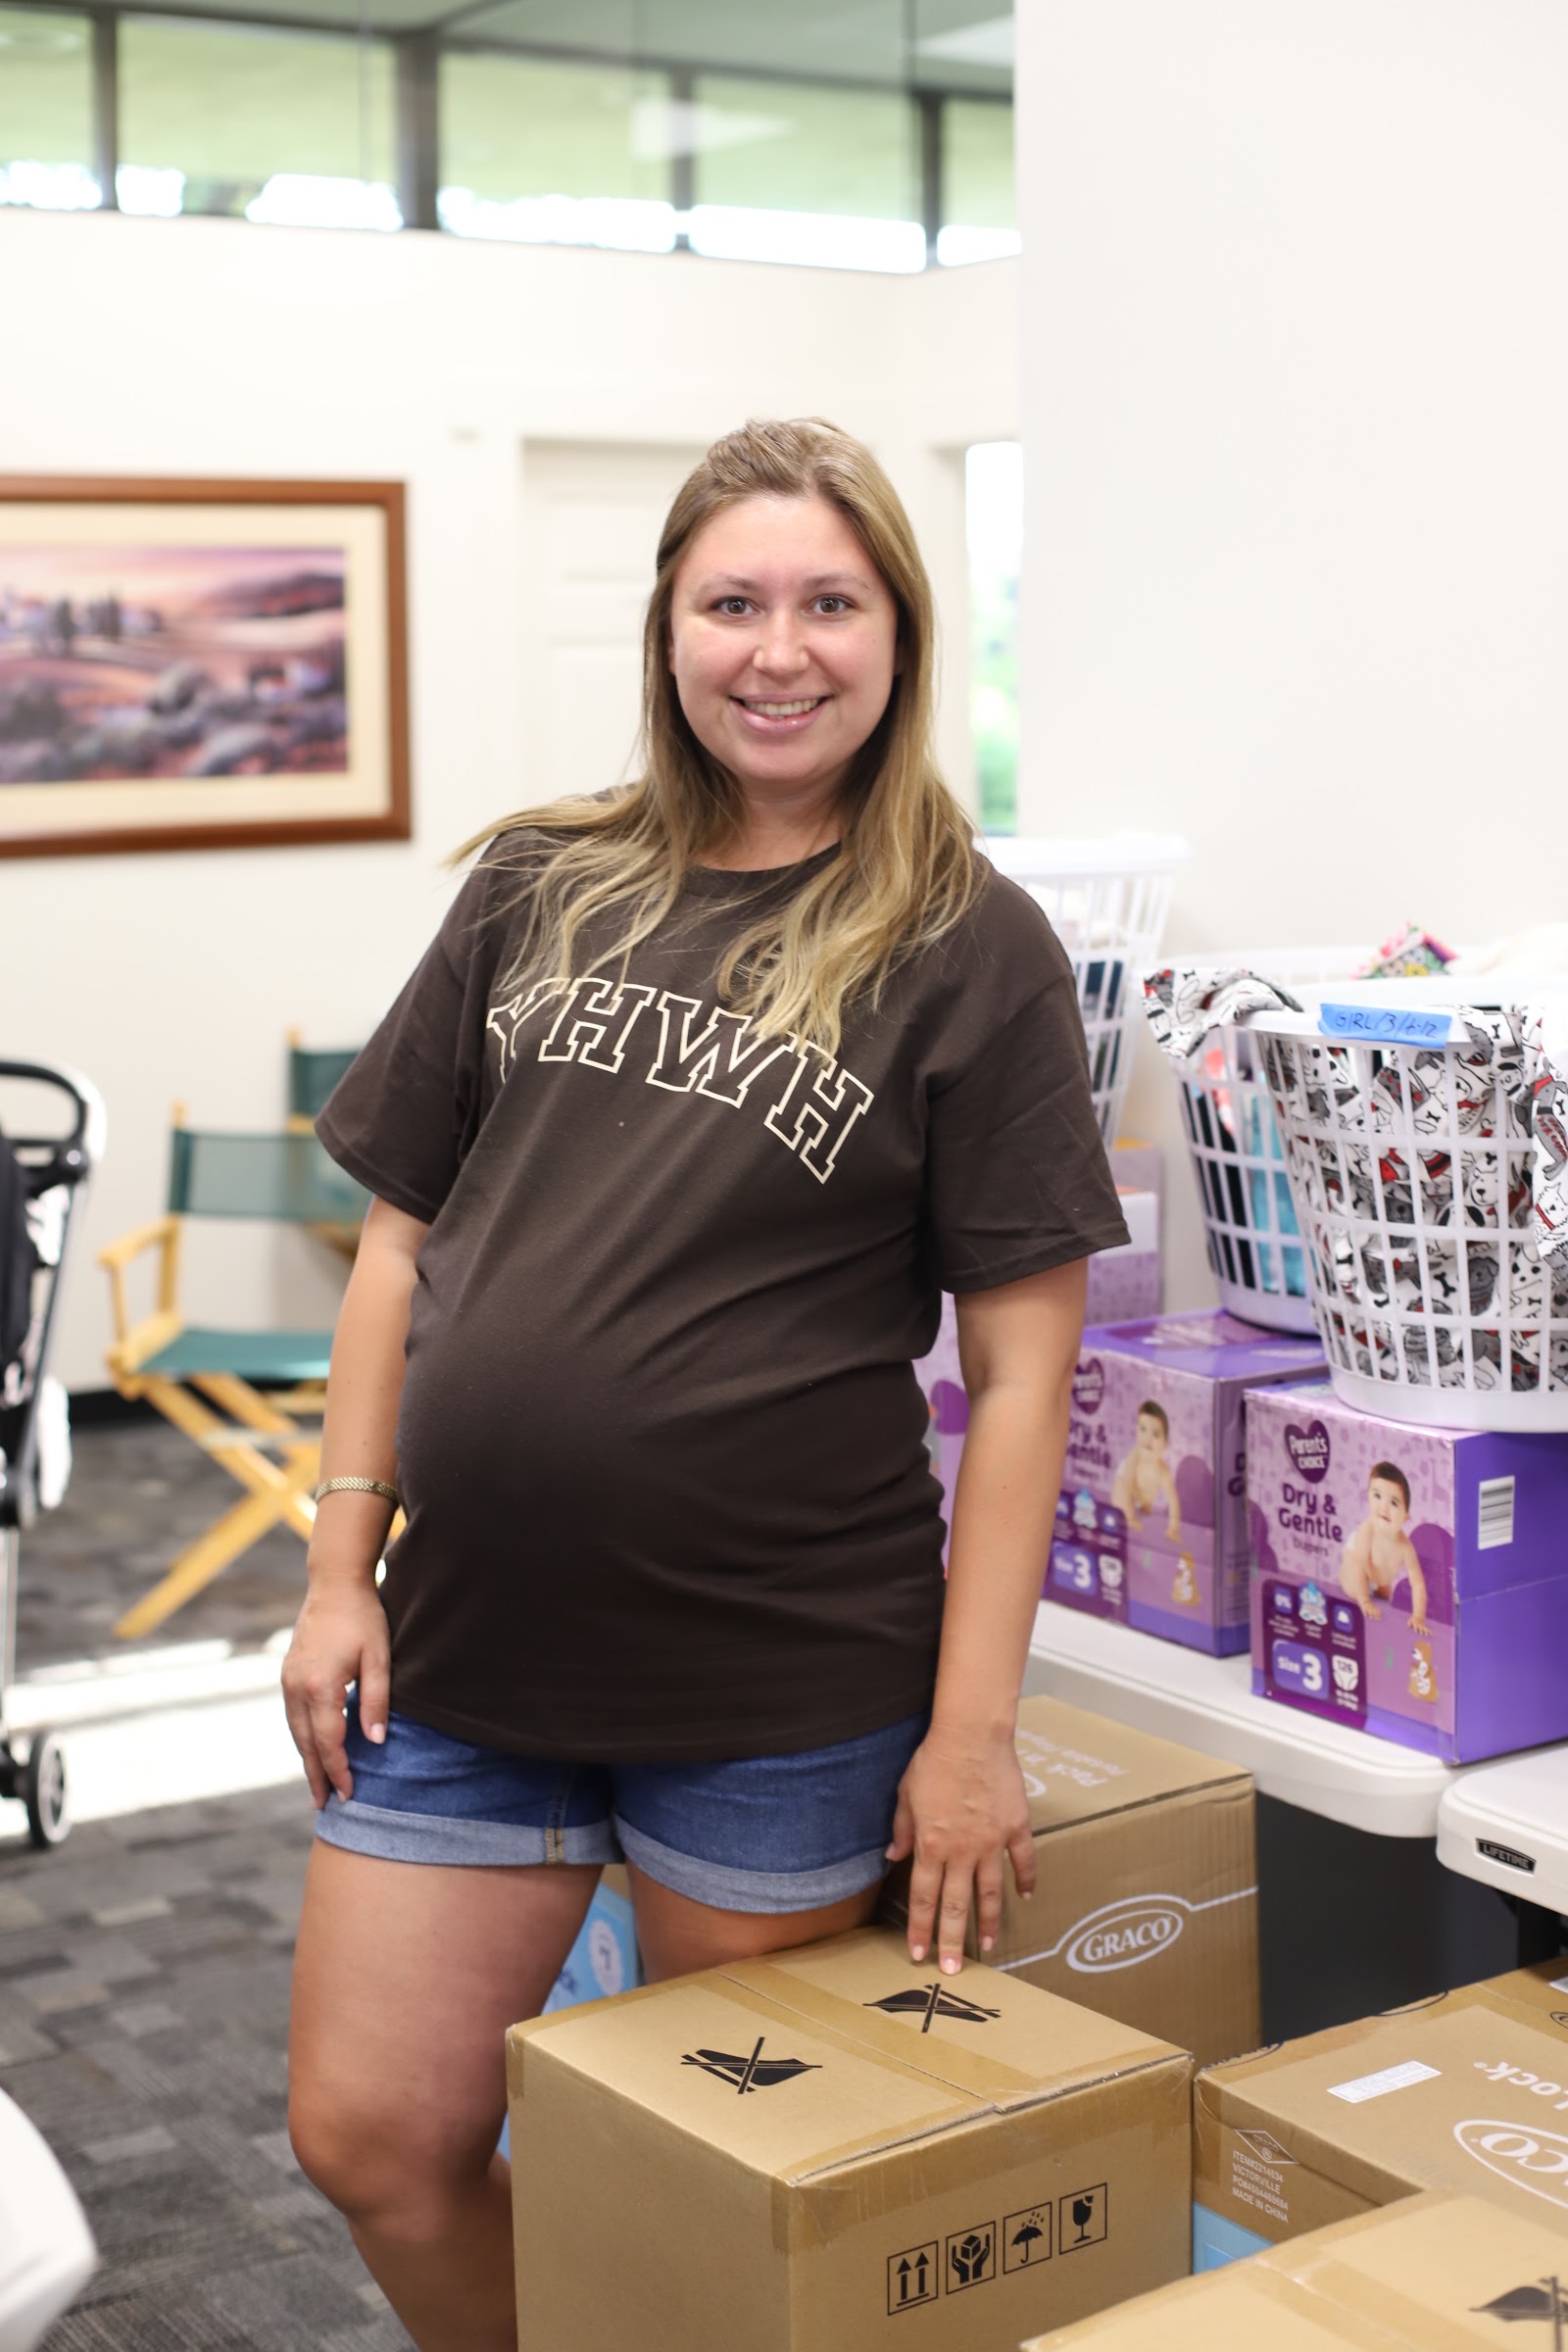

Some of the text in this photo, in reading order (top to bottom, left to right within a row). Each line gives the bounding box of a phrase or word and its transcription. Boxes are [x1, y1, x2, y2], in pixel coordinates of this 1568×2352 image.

[487, 977, 875, 1185] YHWH
[1282, 1483, 1337, 1516] Dry &
[1278, 1507, 1343, 1544] Gentle
[1301, 1652, 1323, 1691] 3
[1483, 1843, 1530, 1869] LIFETIME
[1083, 1917, 1172, 1962] GRACO
[1232, 2162, 1282, 2195] VICTORVILLE
[1232, 2186, 1290, 2225] MADE IN CHINA
